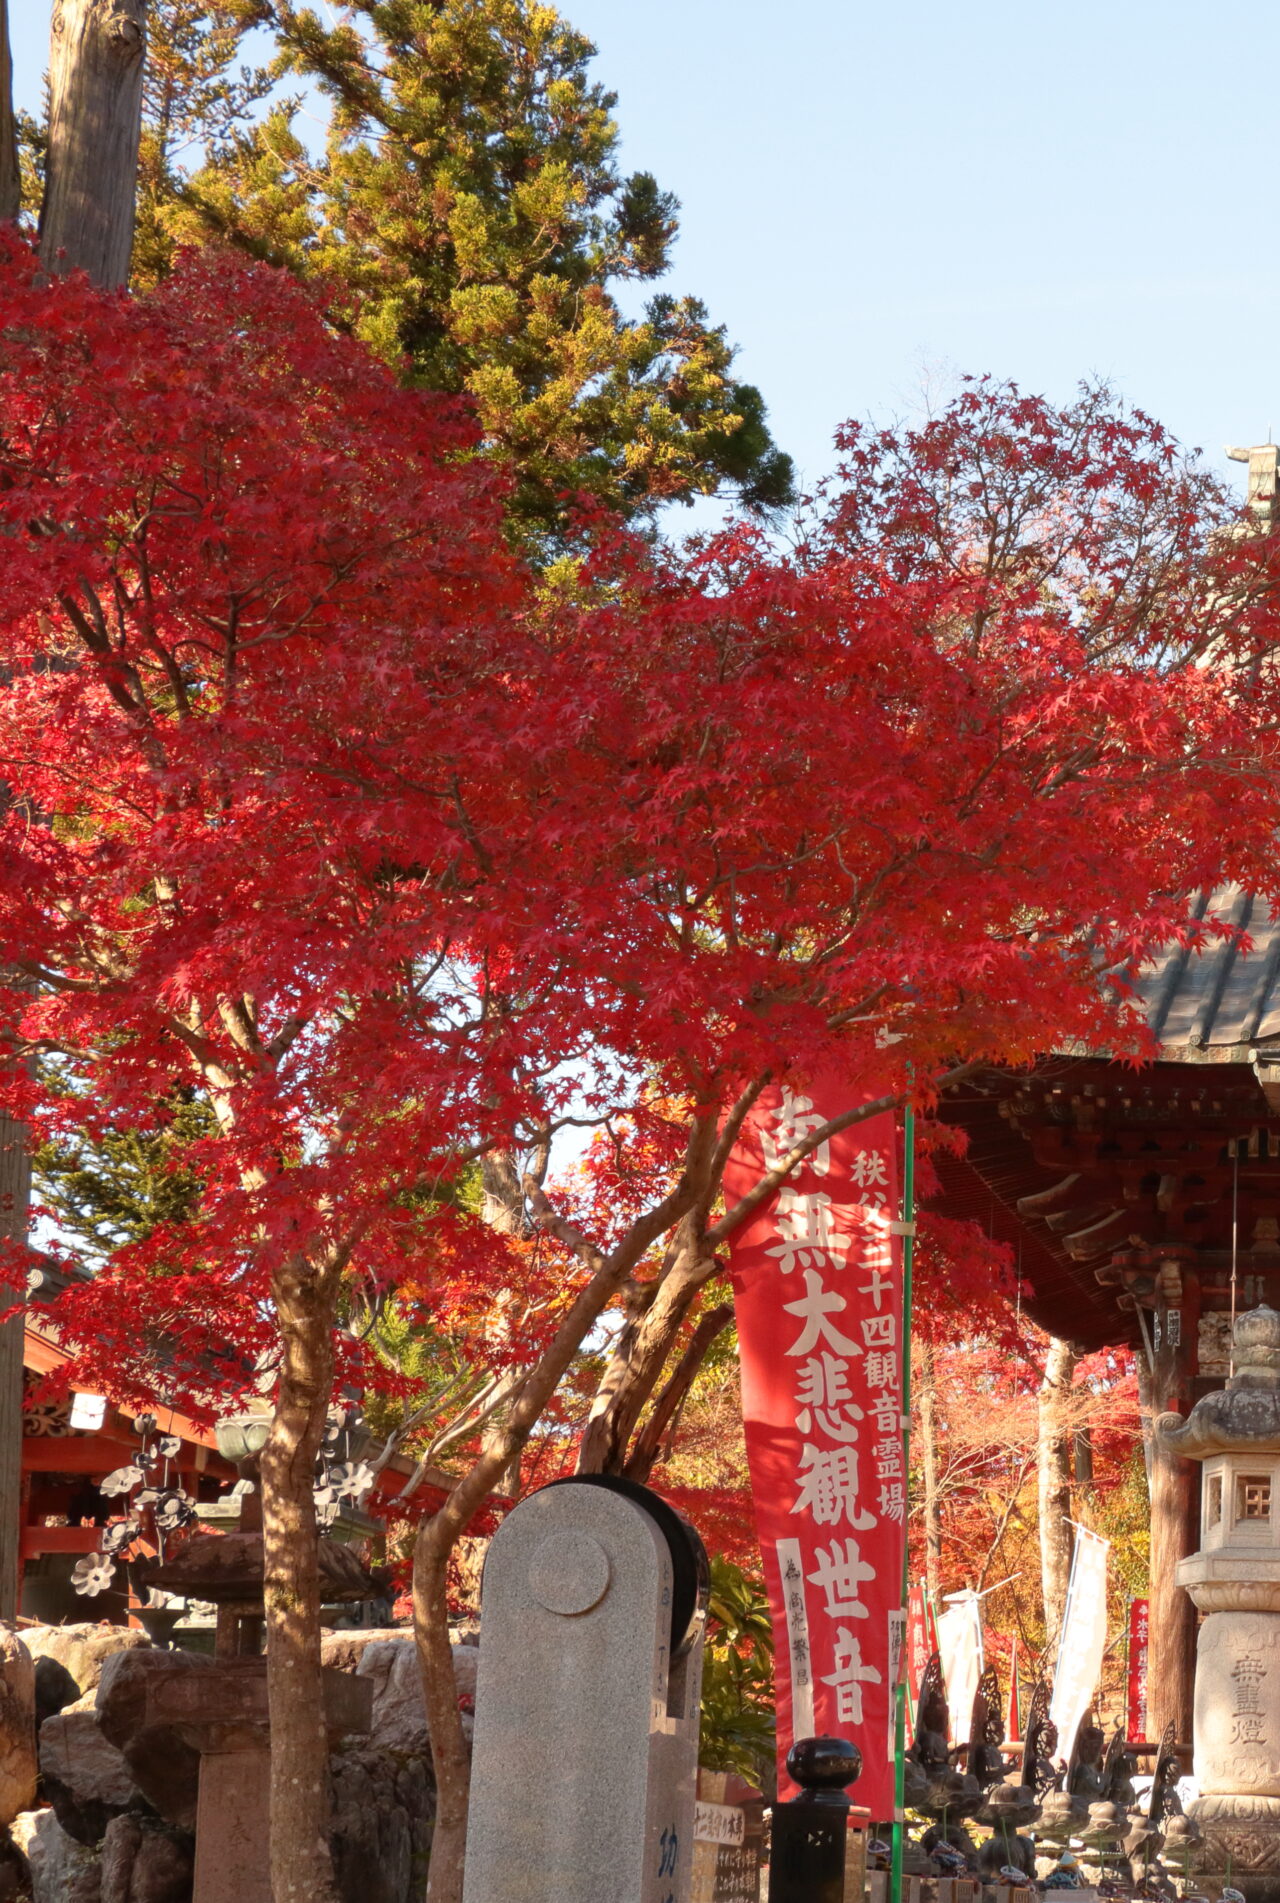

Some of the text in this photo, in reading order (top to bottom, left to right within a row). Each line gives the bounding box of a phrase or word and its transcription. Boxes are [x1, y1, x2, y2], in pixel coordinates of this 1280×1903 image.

[759, 1084, 882, 1725] 南無大悲観世音
[849, 1149, 905, 1527] 秩父三十四観音霊場
